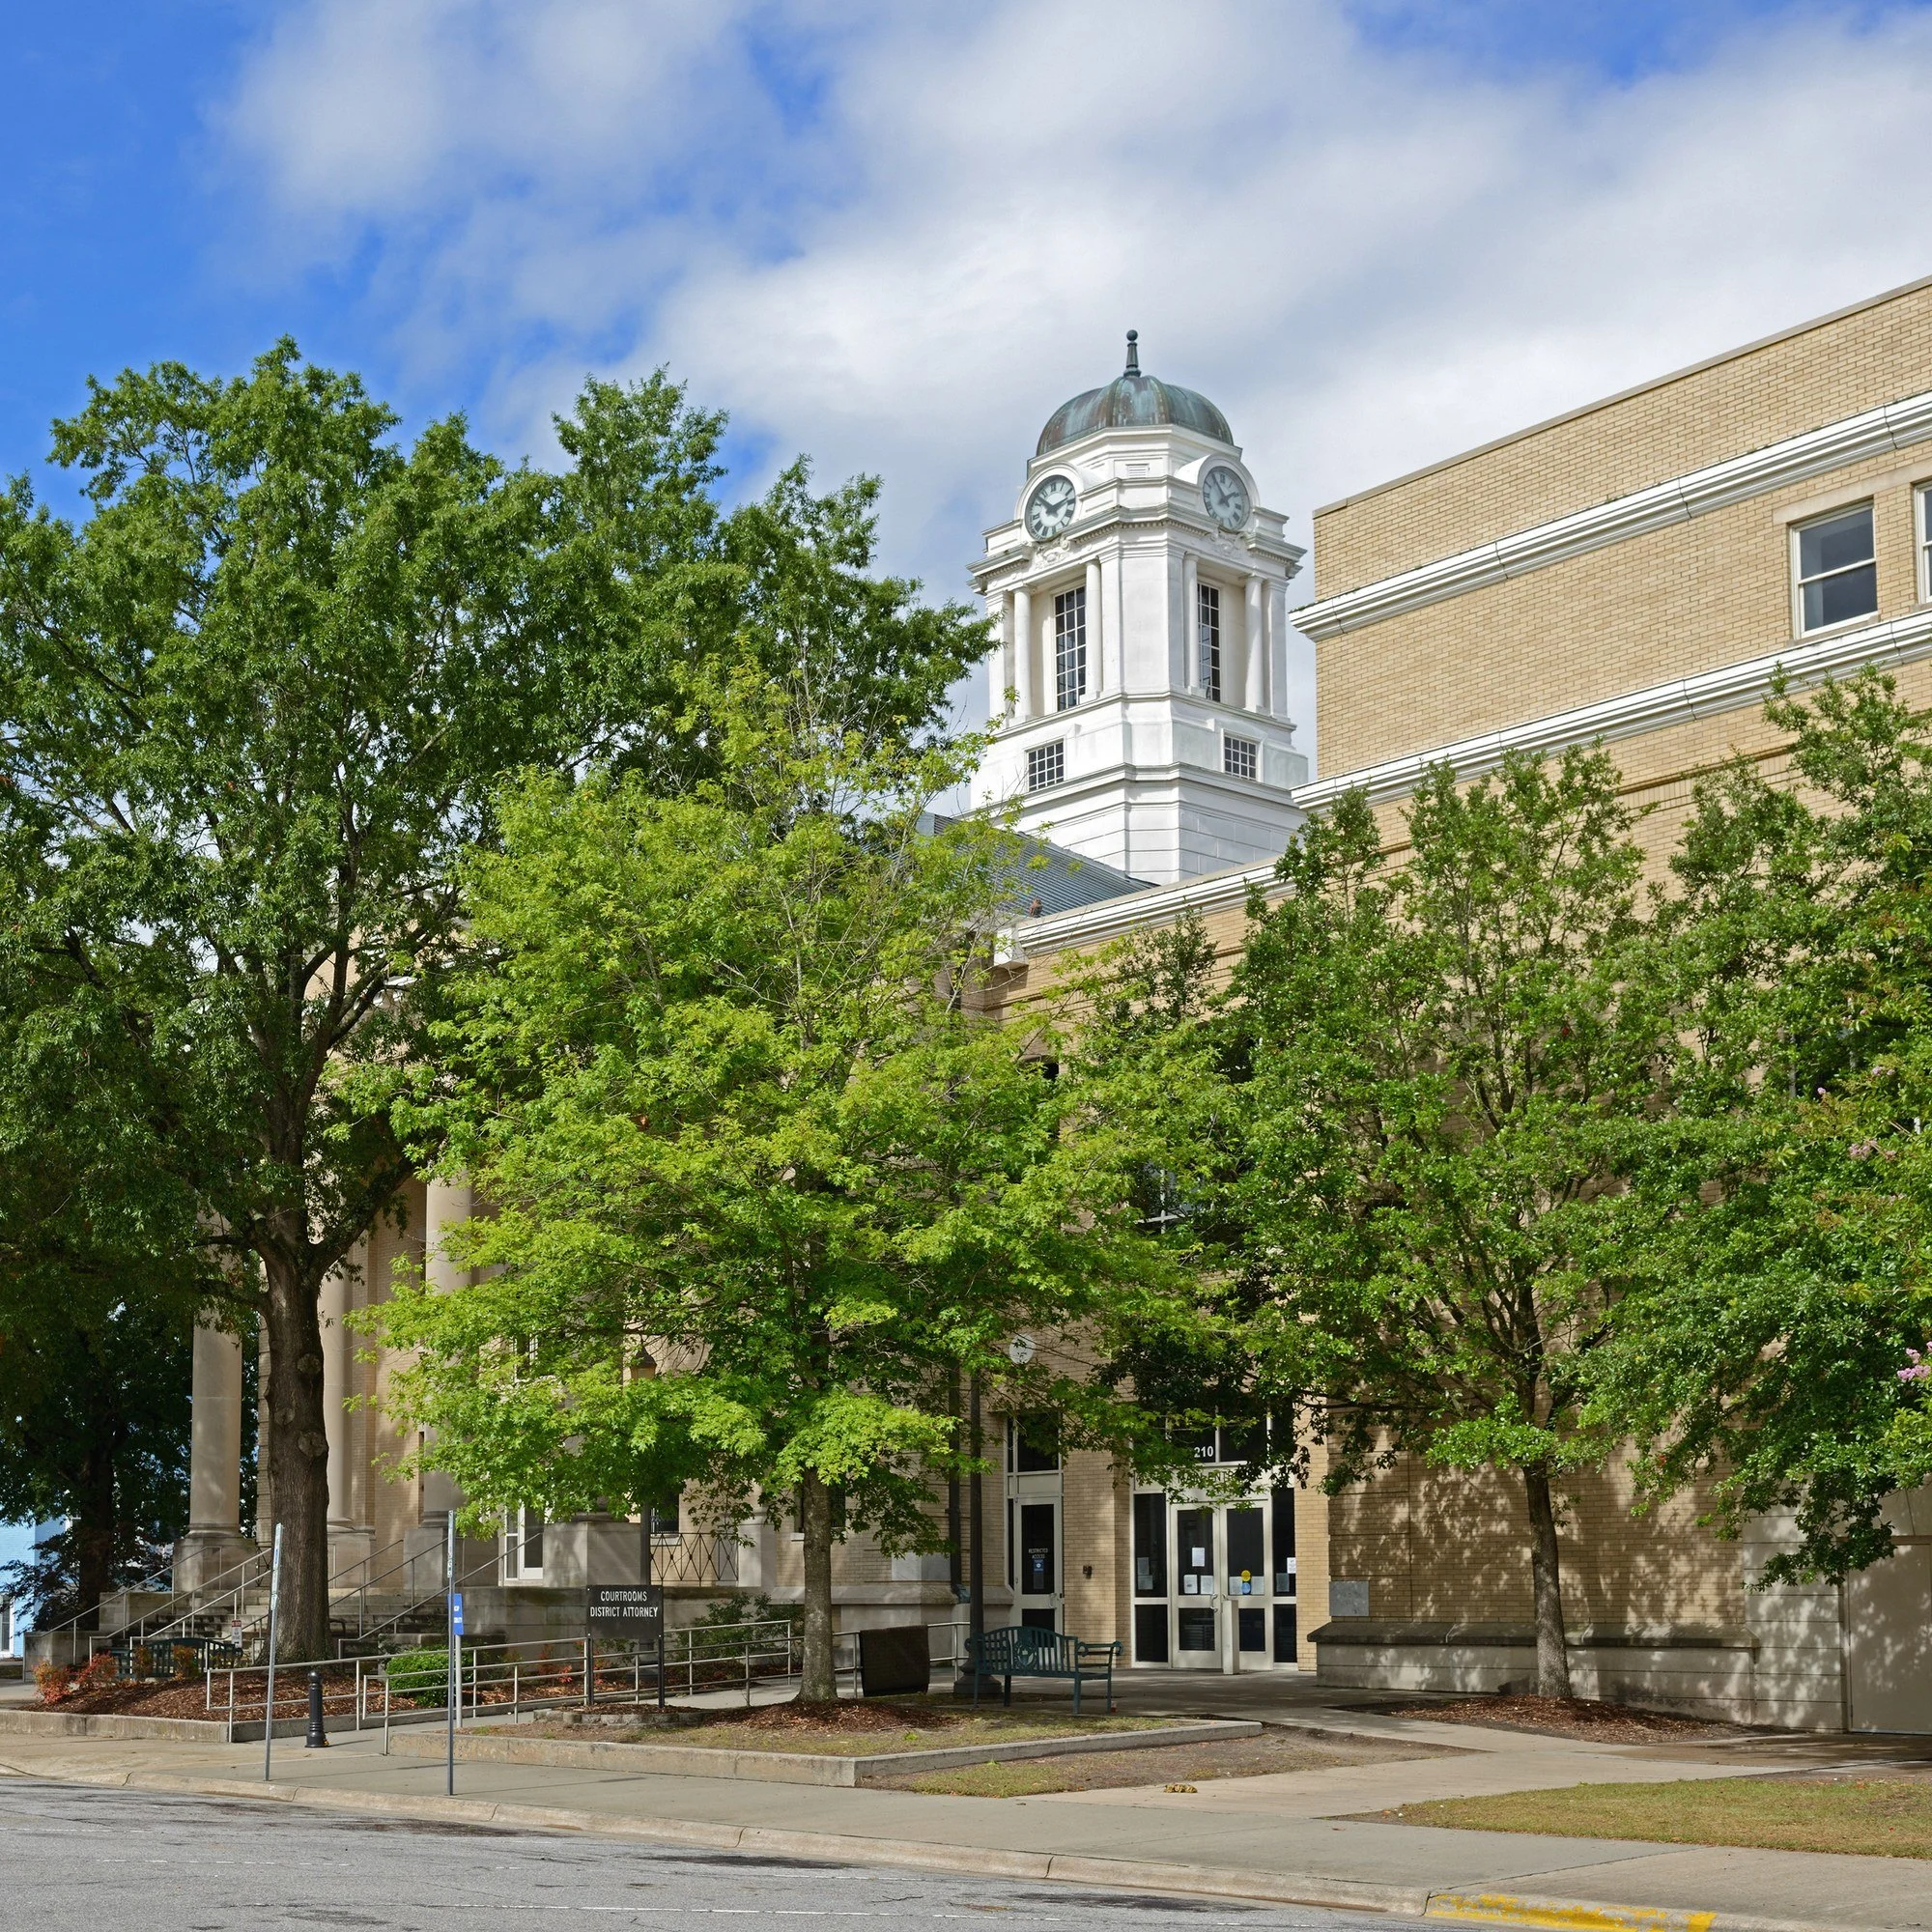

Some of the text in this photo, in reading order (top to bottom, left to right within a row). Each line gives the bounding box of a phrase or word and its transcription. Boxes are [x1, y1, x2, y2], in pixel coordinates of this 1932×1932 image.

[1194, 1445, 1214, 1458] 210
[600, 1590, 647, 1602] COURTROOMS
[589, 1606, 659, 1617] DISTRICT ATTORNEY
